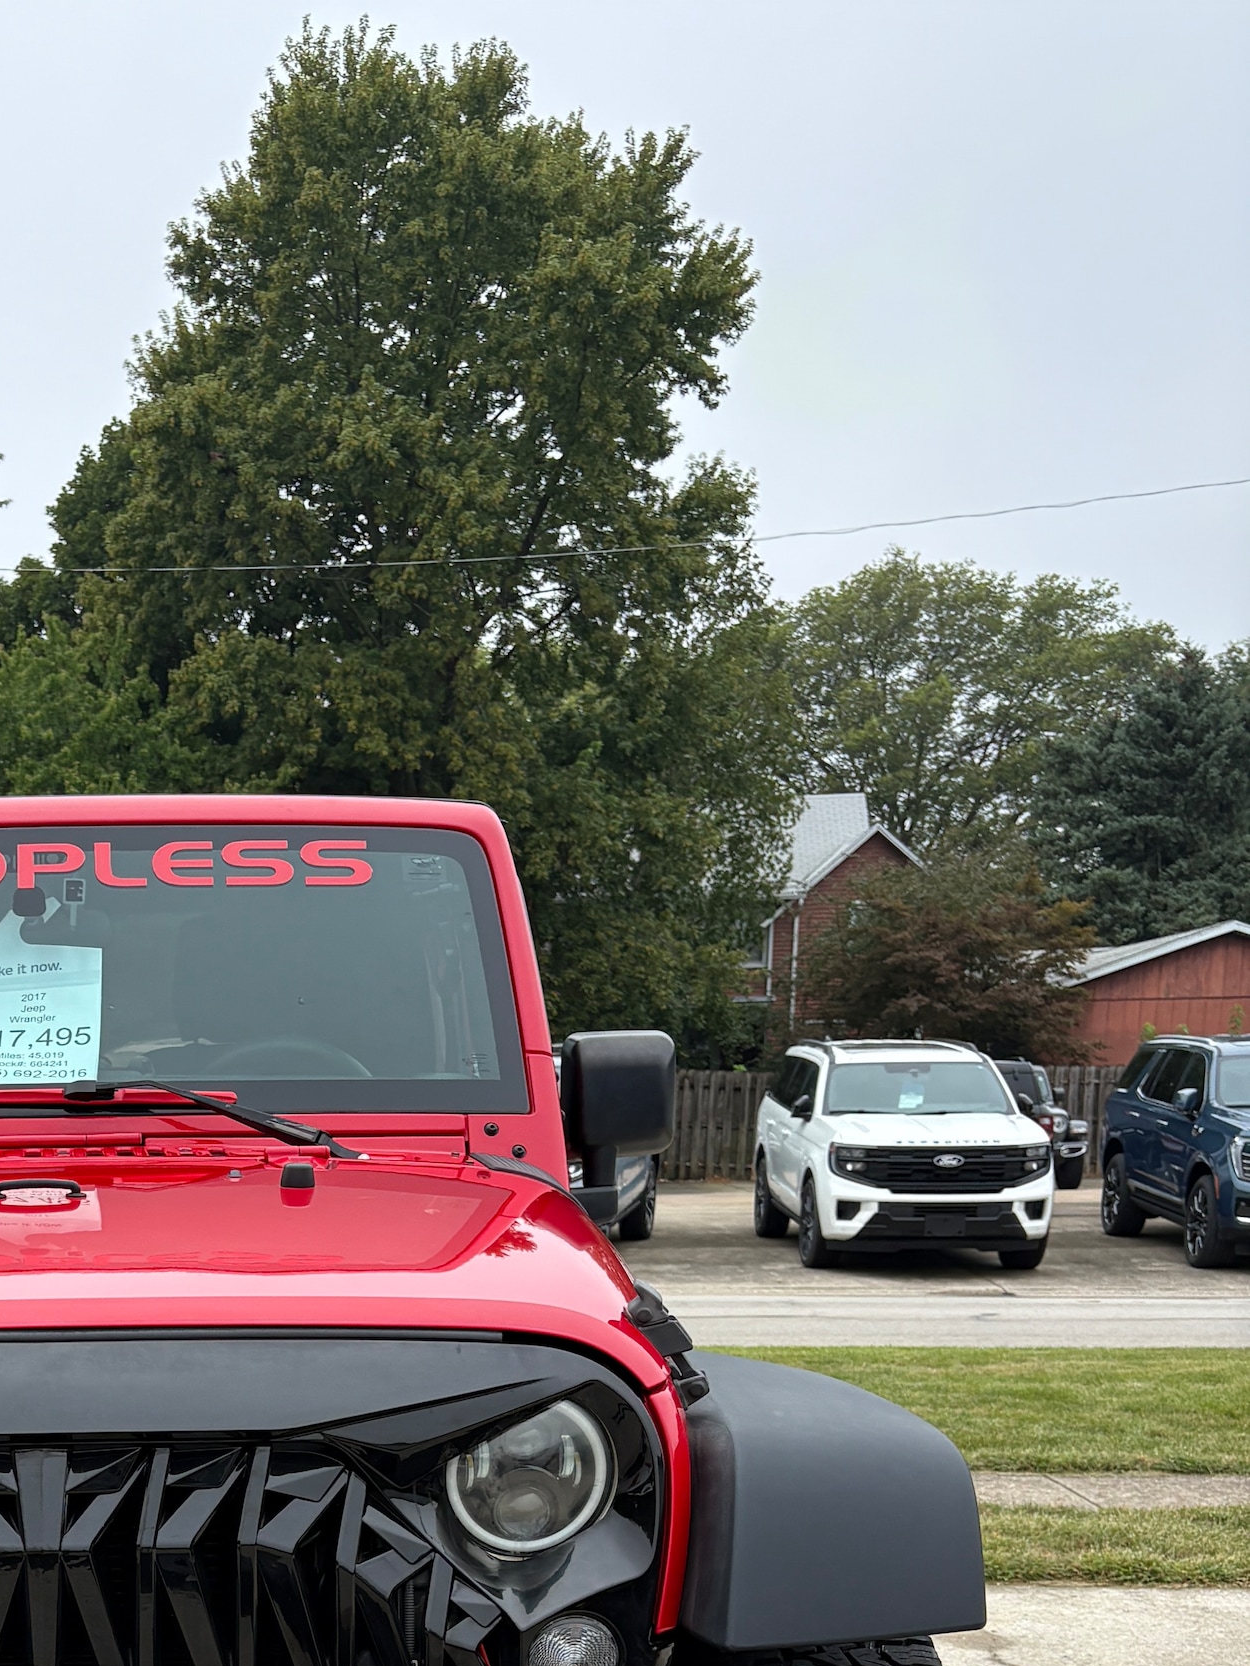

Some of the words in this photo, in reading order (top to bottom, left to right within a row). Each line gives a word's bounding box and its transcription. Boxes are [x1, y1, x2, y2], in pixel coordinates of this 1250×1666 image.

[17, 963, 27, 975] it
[30, 961, 63, 973] now.
[21, 992, 46, 1002] 2017
[20, 1004, 46, 1013] Jeep
[9, 1014, 56, 1024] Wrangler
[28, 1051, 64, 1059] 45,019
[13, 1068, 87, 1078] 692-2016
